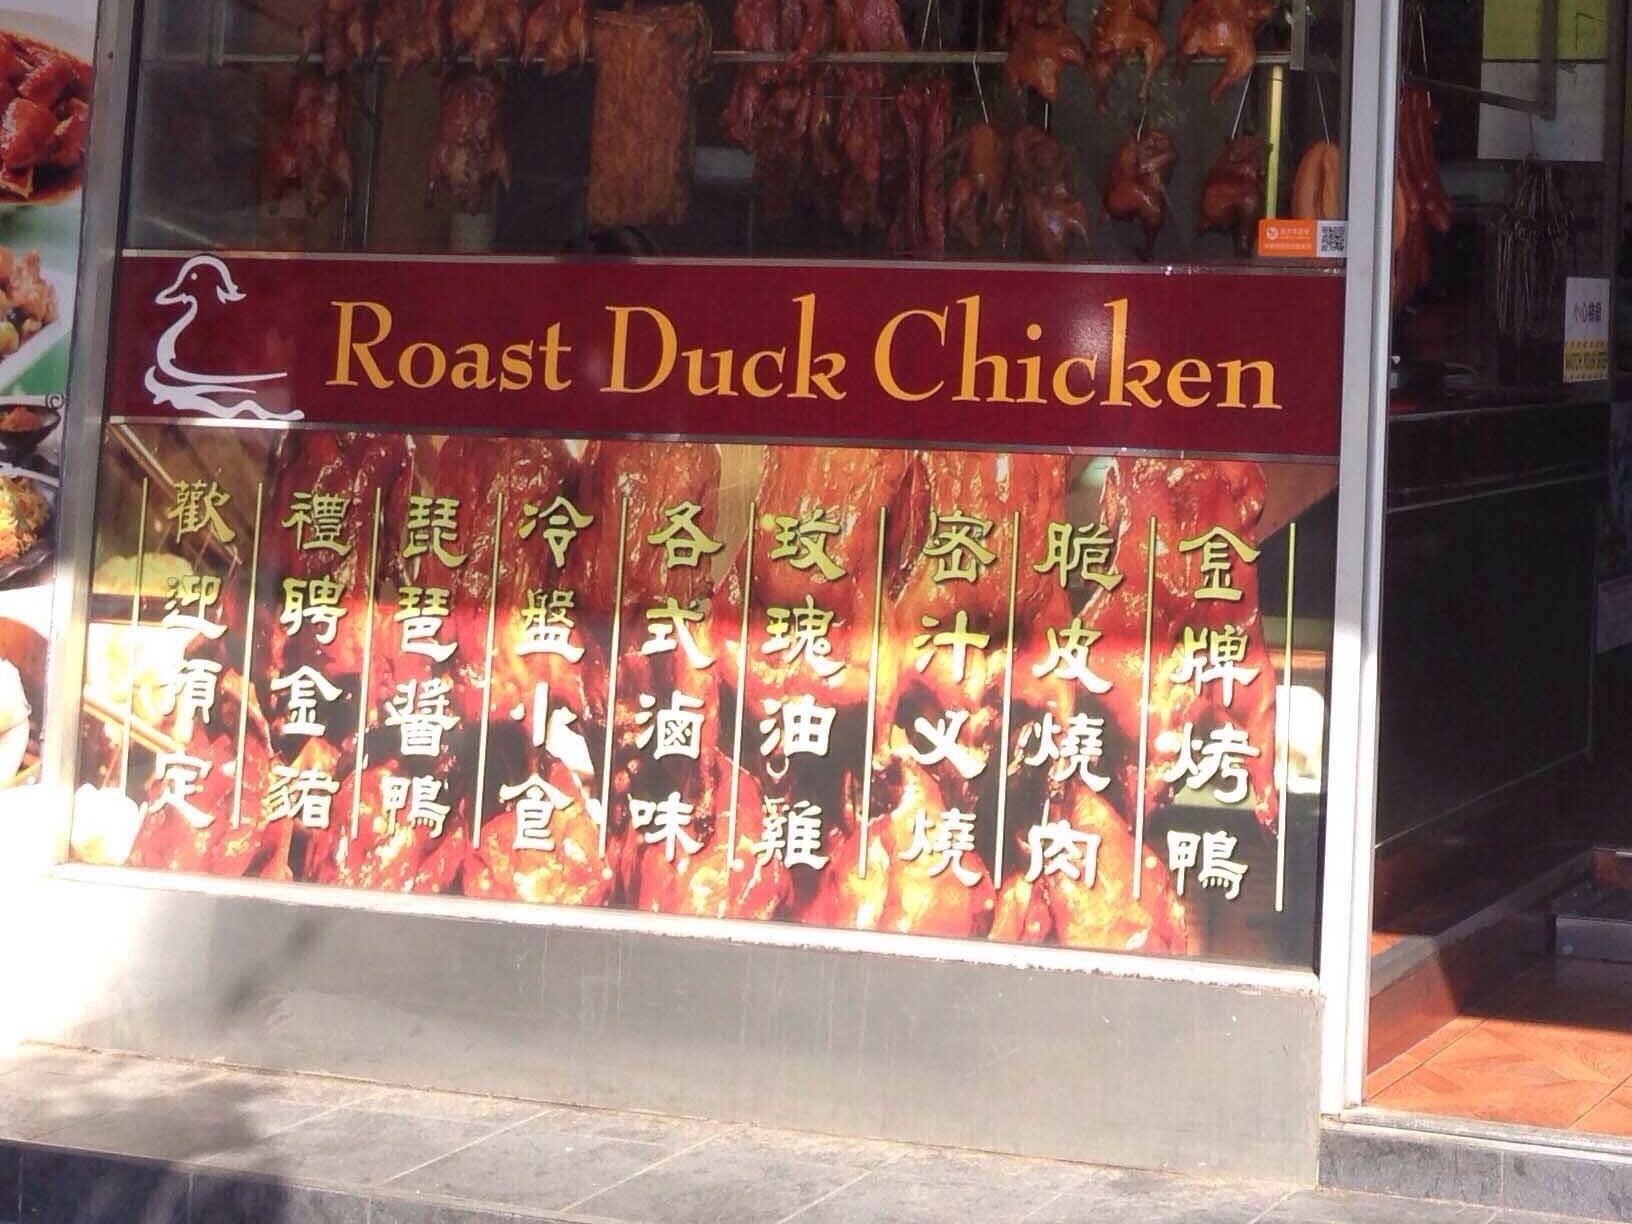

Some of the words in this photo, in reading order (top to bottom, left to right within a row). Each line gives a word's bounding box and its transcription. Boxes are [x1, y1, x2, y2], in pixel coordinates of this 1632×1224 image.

[330, 298, 572, 392] Roast
[602, 292, 848, 401] Duck
[873, 294, 1283, 412] Chicken
[500, 495, 595, 853] 冷盤小食
[1023, 522, 1125, 889] 脆皮燒肉
[1163, 525, 1262, 902] 金牌烤鴨
